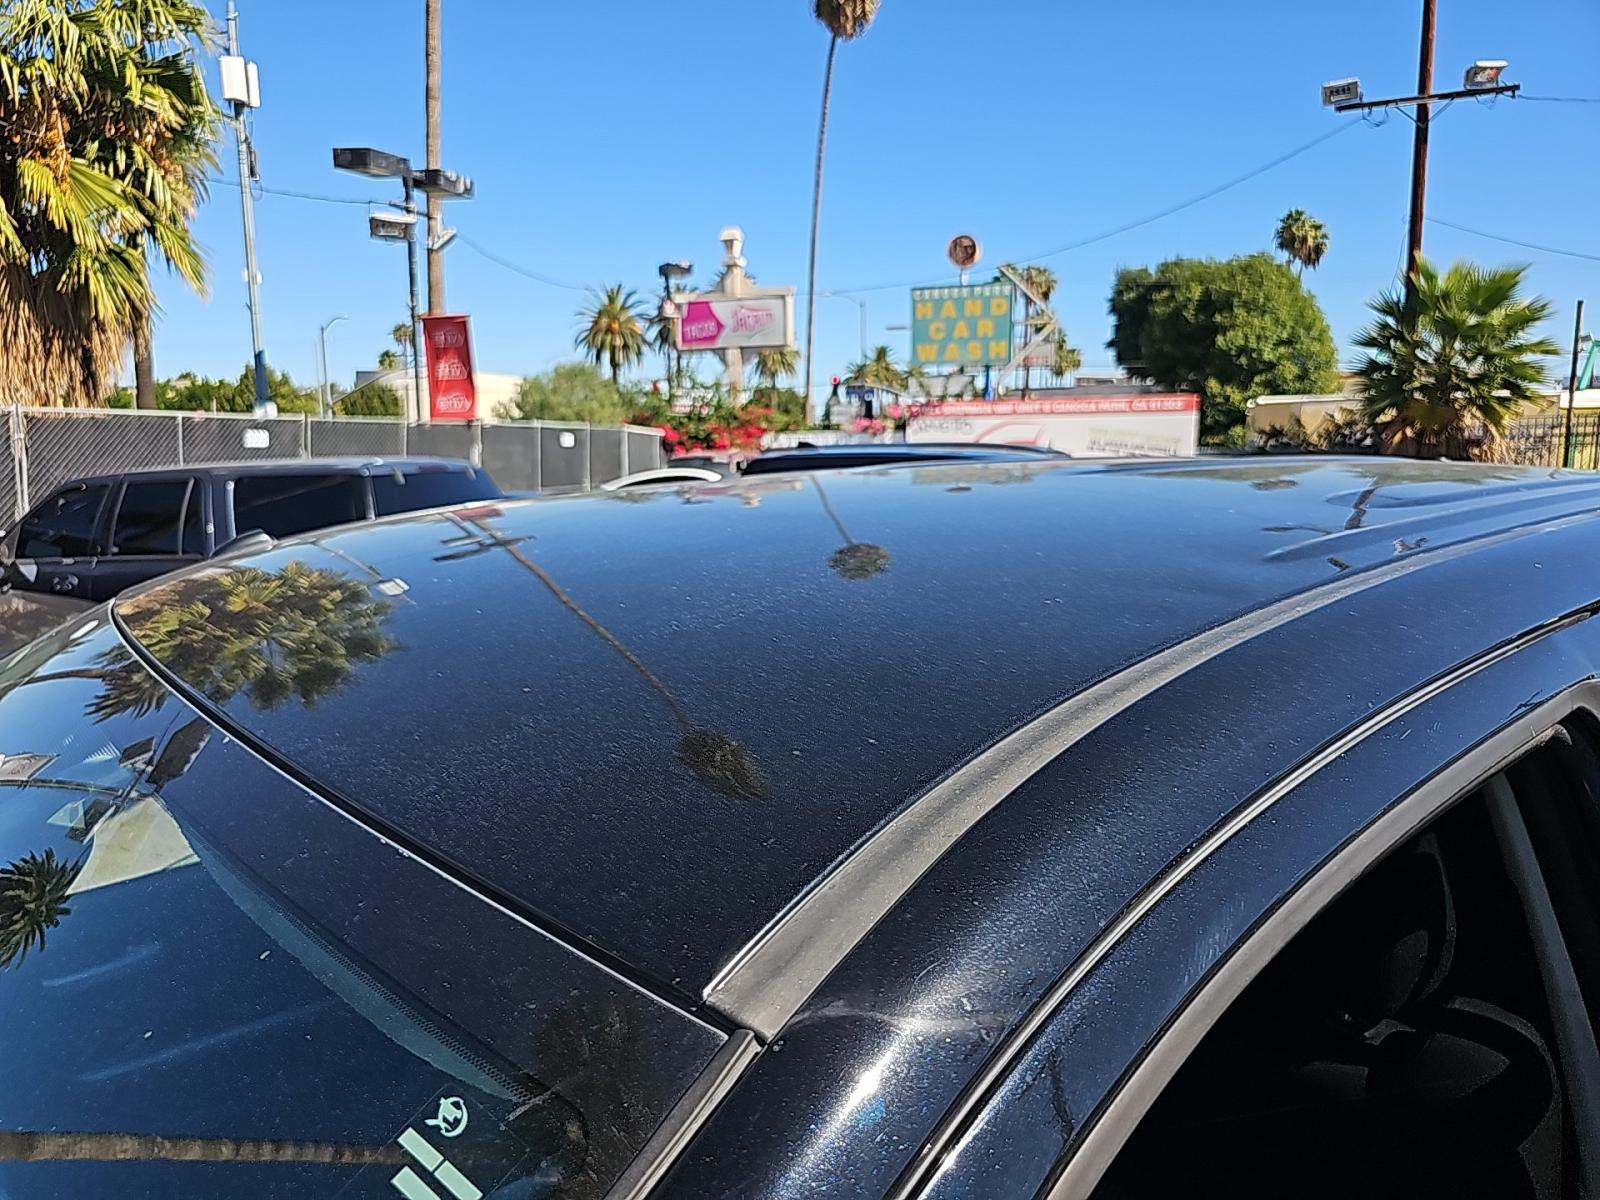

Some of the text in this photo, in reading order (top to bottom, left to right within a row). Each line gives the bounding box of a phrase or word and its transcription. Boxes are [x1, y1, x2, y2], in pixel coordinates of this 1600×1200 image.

[915, 298, 1009, 320] HAND
[928, 318, 994, 340] CAR
[917, 341, 1008, 361] WASH
